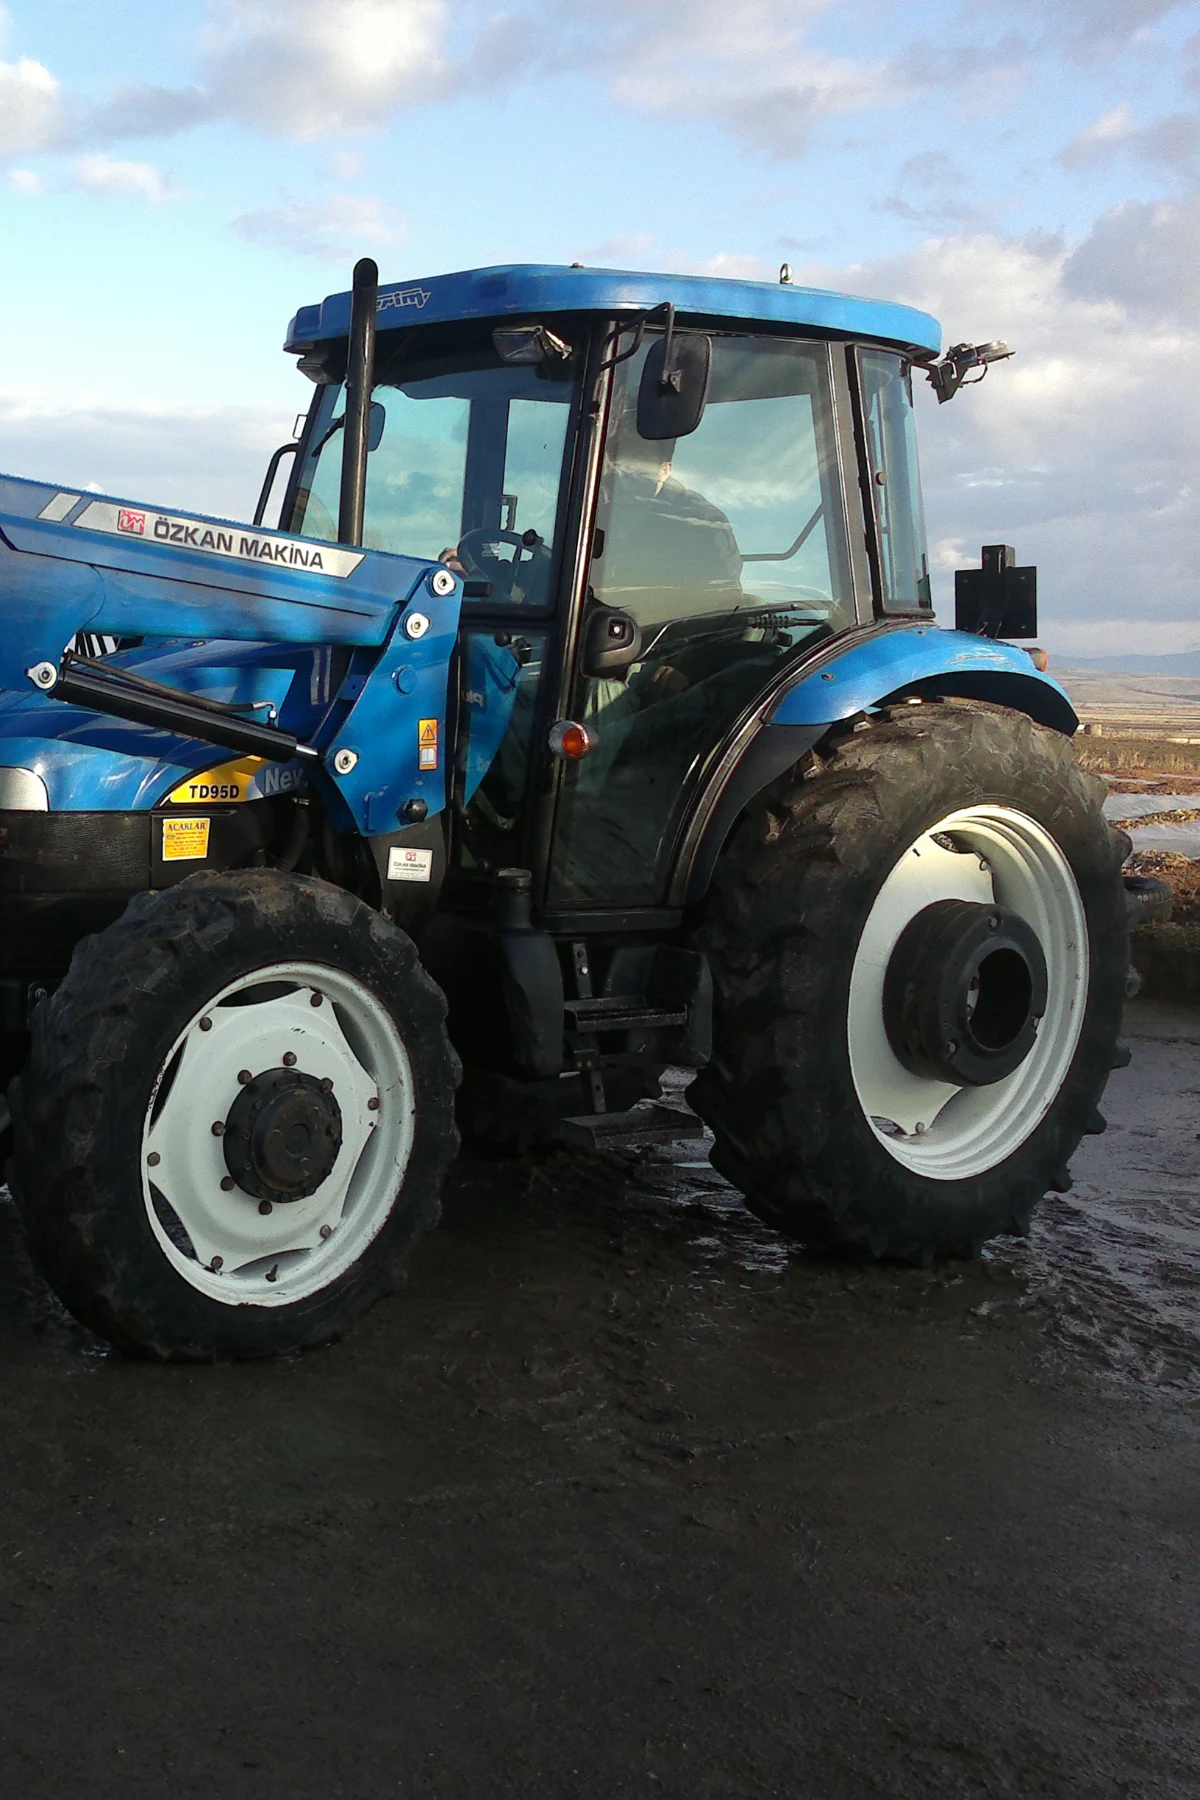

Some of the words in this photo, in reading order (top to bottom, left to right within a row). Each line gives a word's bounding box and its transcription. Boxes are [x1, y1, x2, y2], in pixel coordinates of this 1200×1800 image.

[153, 517, 233, 551] ÖZKAN
[239, 537, 324, 570] MAKİNA
[189, 784, 240, 799] TD95D
